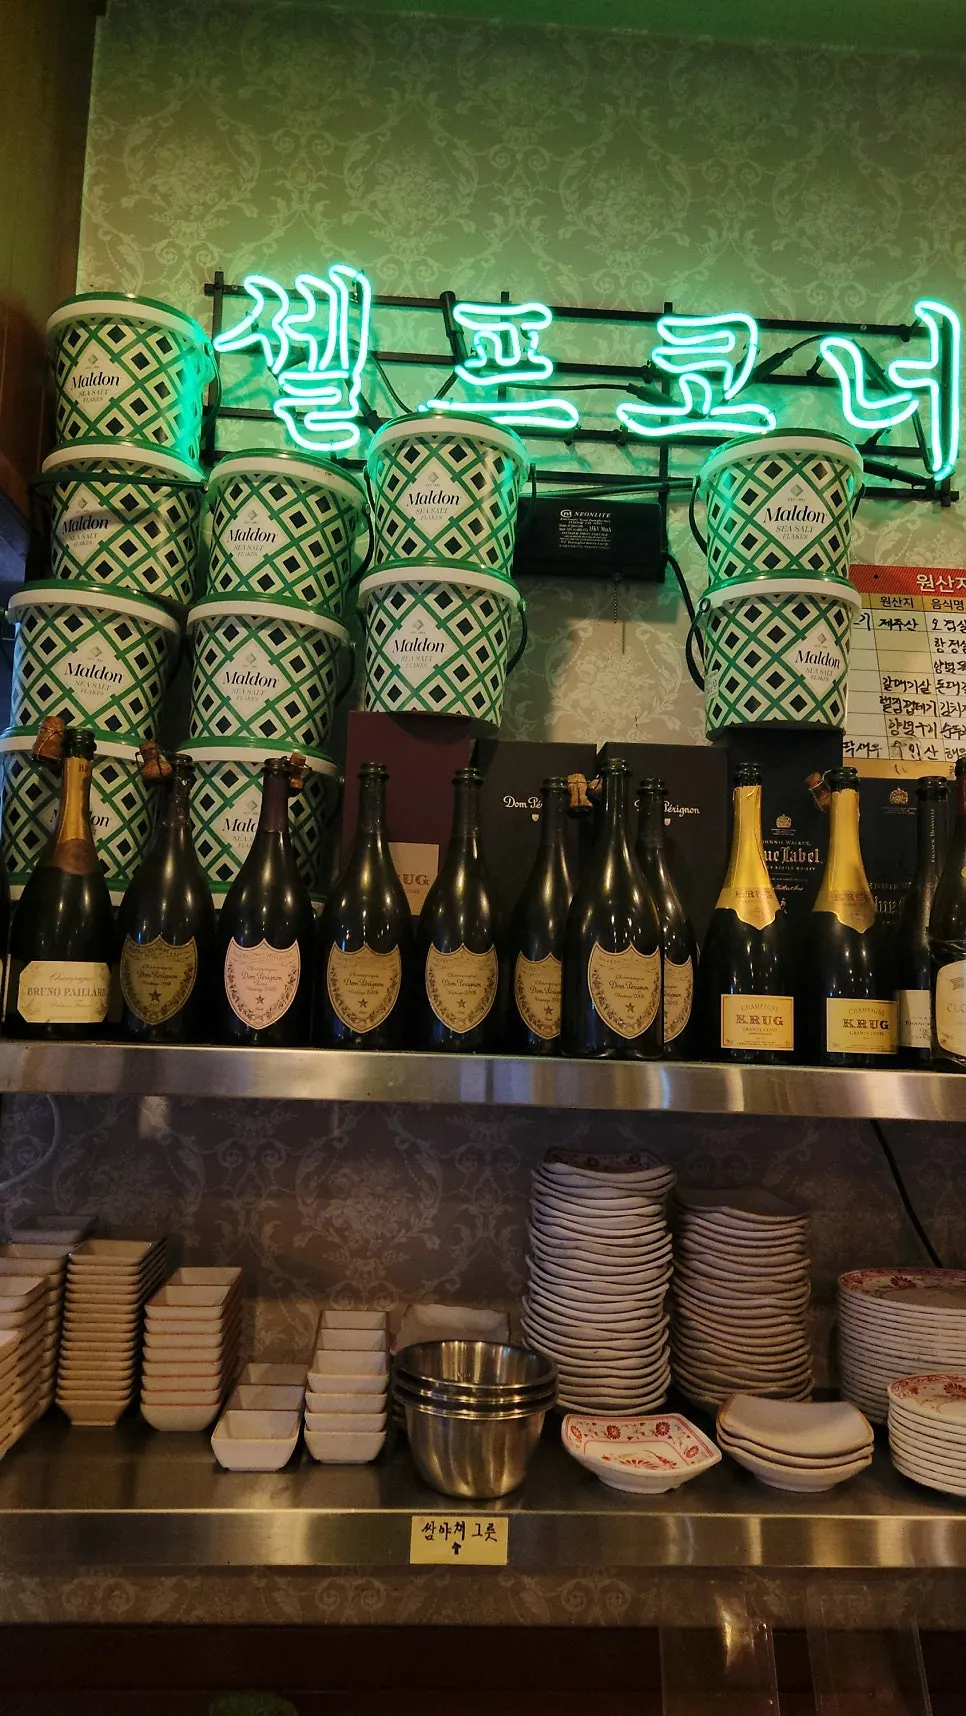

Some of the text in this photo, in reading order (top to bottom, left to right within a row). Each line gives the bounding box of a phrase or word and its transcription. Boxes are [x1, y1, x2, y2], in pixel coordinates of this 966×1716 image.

[213, 263, 963, 481] 셀프코너
[71, 372, 120, 390] Maldon
[407, 490, 459, 506] Maldon
[763, 505, 826, 524] Maldon
[62, 516, 109, 535] Maldon
[227, 528, 276, 543] Maldon
[880, 596, 914, 608] 원산지
[931, 598, 964, 610] 음식명
[878, 618, 919, 631] 제주산
[393, 637, 445, 653] Maldon
[795, 650, 840, 669] Maldon
[64, 662, 123, 684] Maldon
[222, 671, 277, 688] Maldon
[882, 676, 931, 694] 갈매기살
[888, 718, 938, 739] 양념구이
[503, 795, 528, 808] Dom
[222, 818, 258, 832] Mal
[764, 846, 820, 864] ue Label
[401, 874, 429, 886] UG
[27, 987, 107, 997] BRUNO PAILLARD
[735, 1014, 784, 1026] KRUG
[842, 1018, 889, 1030] KRUG
[421, 1521, 498, 1542] 쌈야채 그릇
